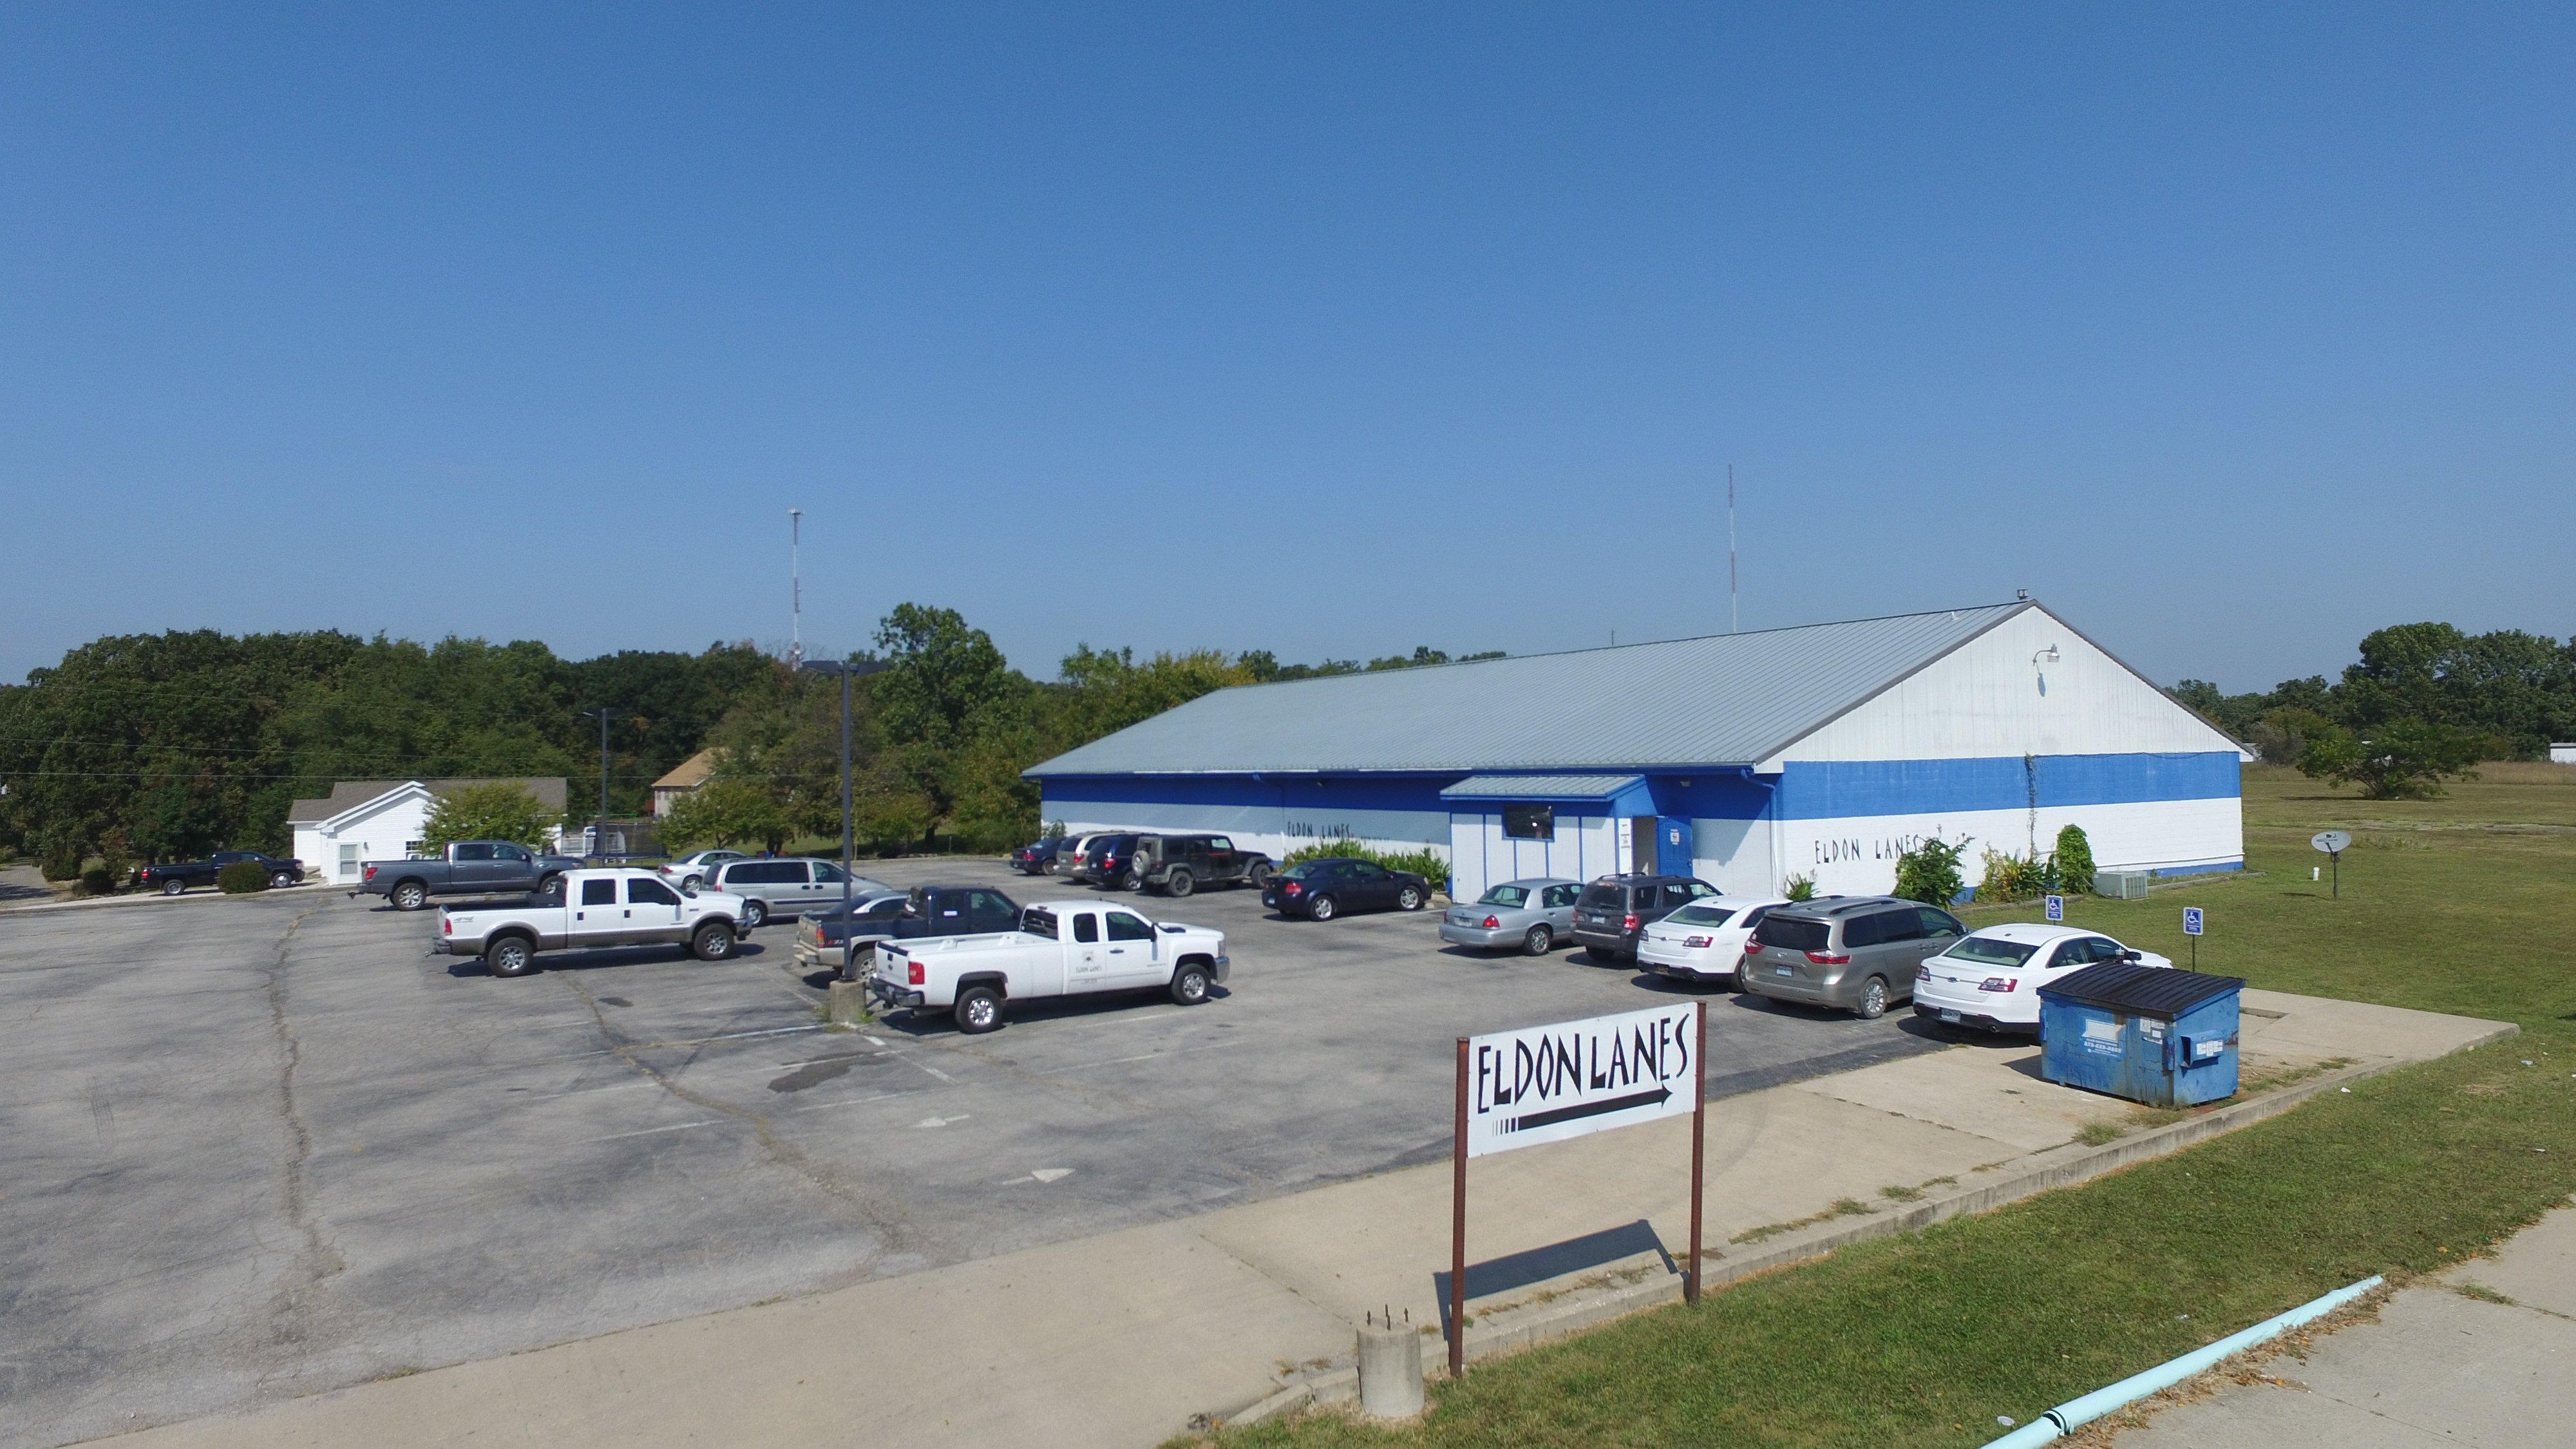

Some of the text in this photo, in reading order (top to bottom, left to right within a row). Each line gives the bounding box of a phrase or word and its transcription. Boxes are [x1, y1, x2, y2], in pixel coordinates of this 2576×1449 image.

[1287, 821, 1313, 837] ELDON
[1815, 834, 1919, 864] ELDON LANES
[1477, 1012, 1690, 1114] ELDON LANES
